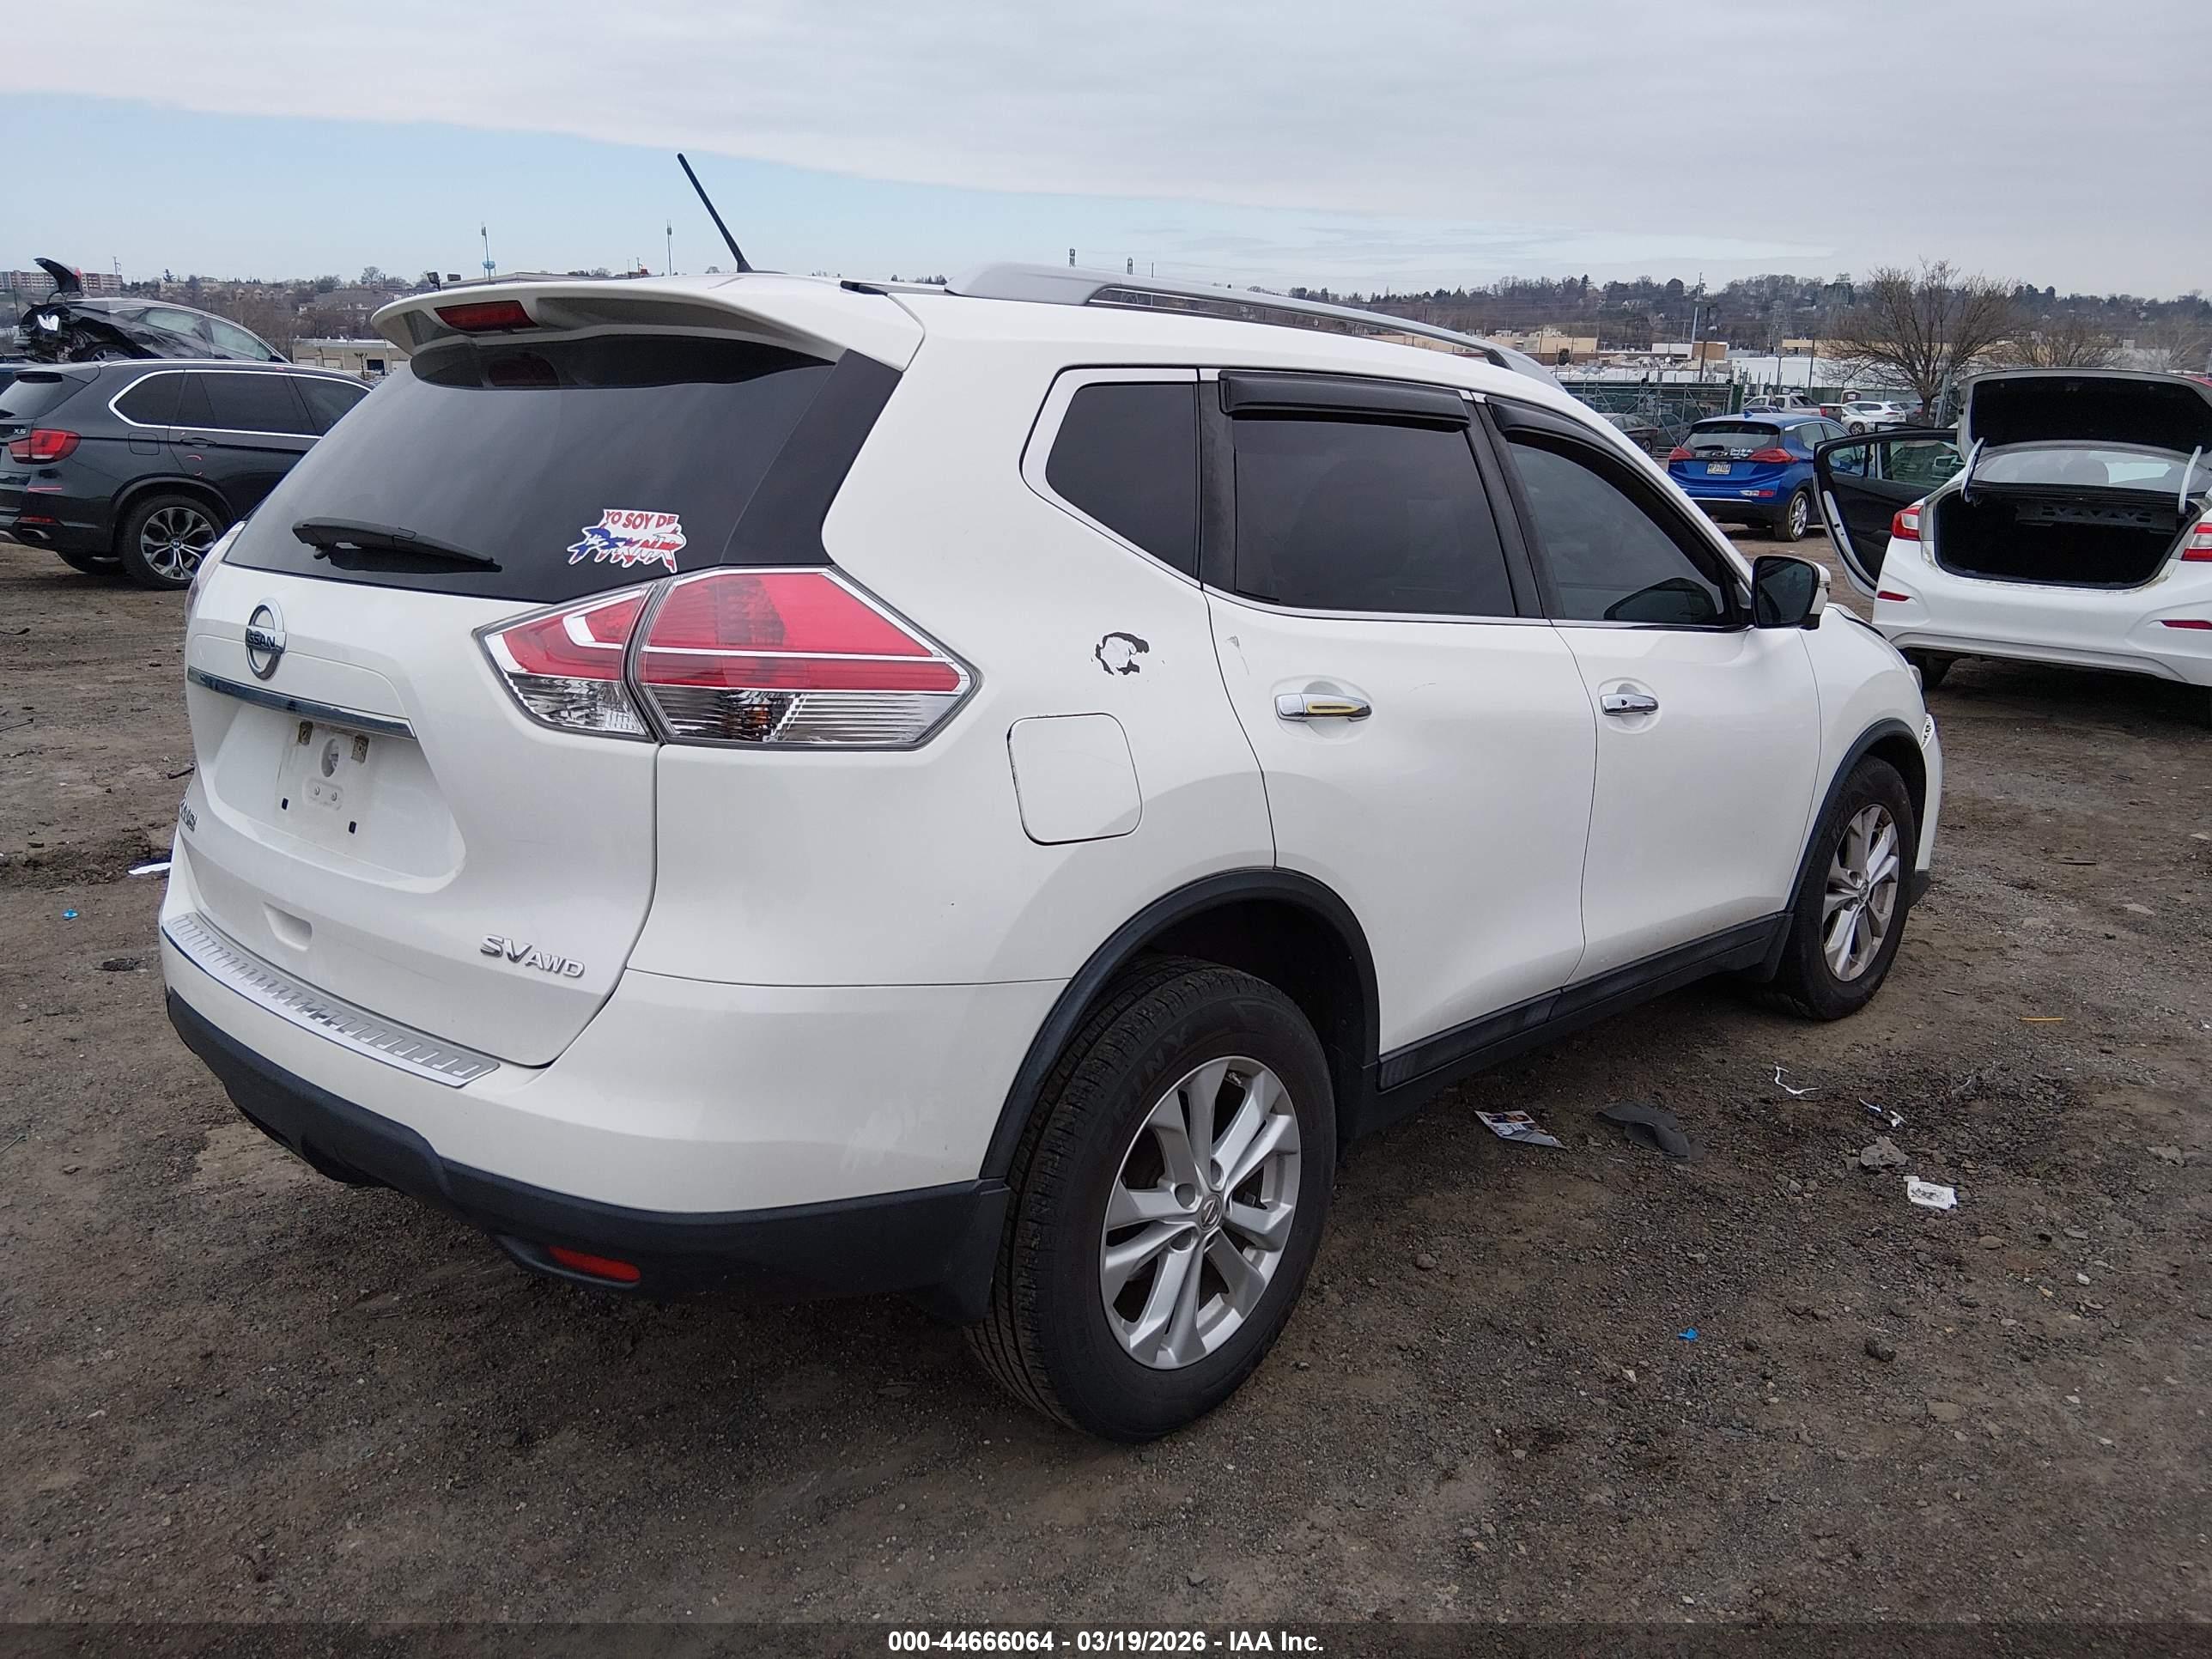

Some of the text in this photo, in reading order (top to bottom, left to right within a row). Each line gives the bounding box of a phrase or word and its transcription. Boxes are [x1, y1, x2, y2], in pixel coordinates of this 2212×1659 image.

[605, 511, 676, 529] YO SOY DE
[480, 934, 586, 978] SV AWD
